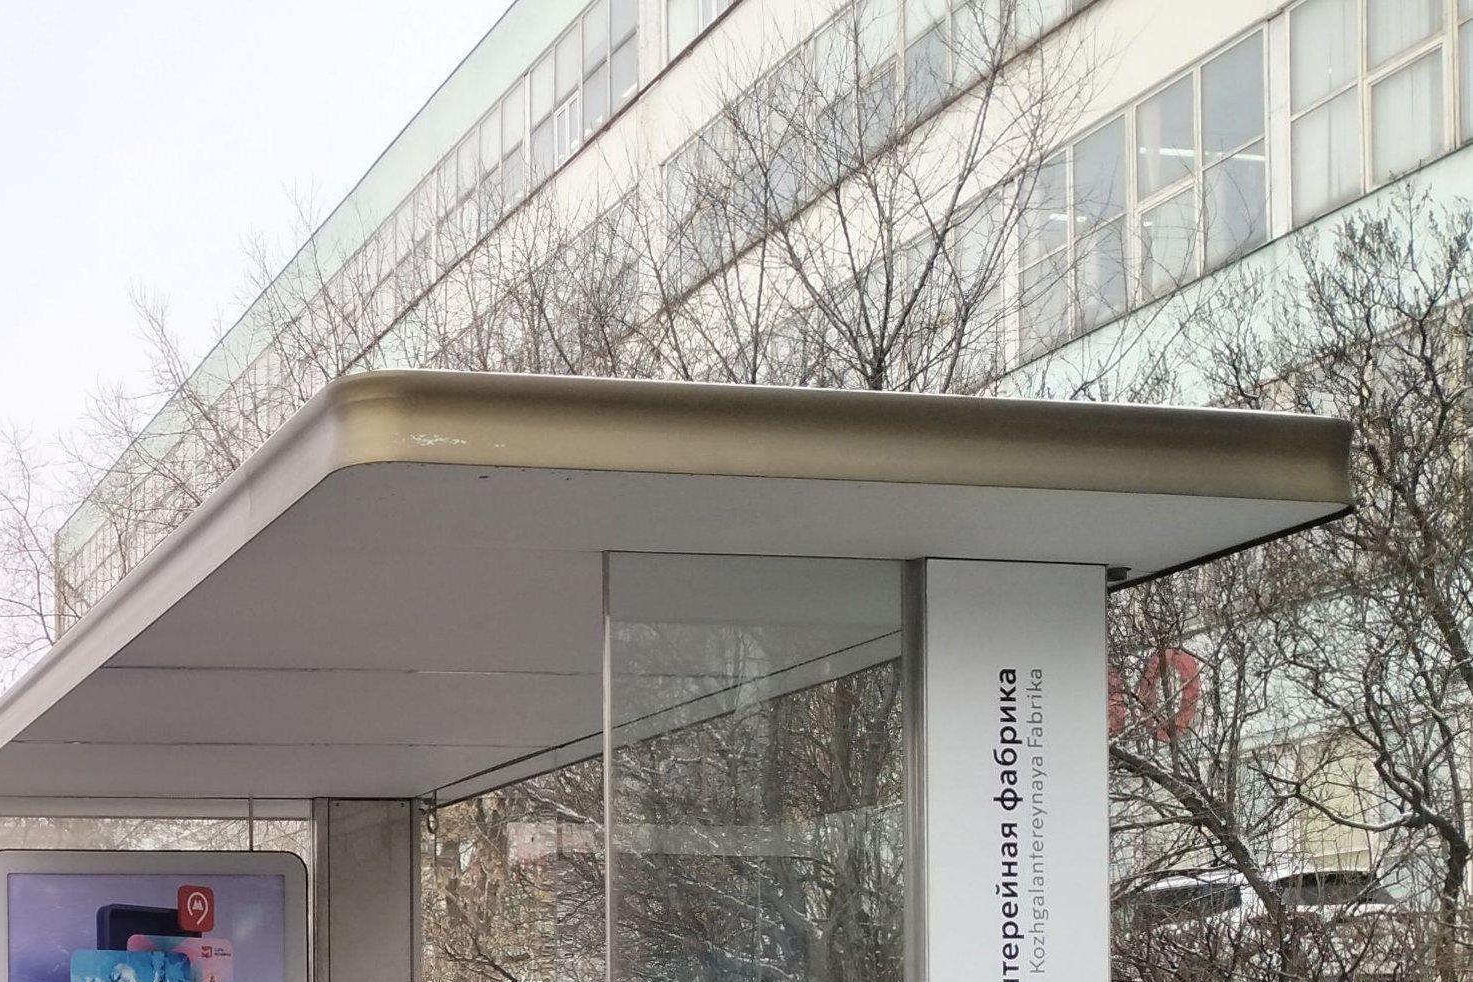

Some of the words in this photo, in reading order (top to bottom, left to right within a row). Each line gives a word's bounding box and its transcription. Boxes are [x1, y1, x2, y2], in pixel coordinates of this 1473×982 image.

[992, 667, 1024, 812] фабрика
[1025, 667, 1043, 748] Fabrika
[1027, 755, 1049, 974] Kozhgalantereynaya
